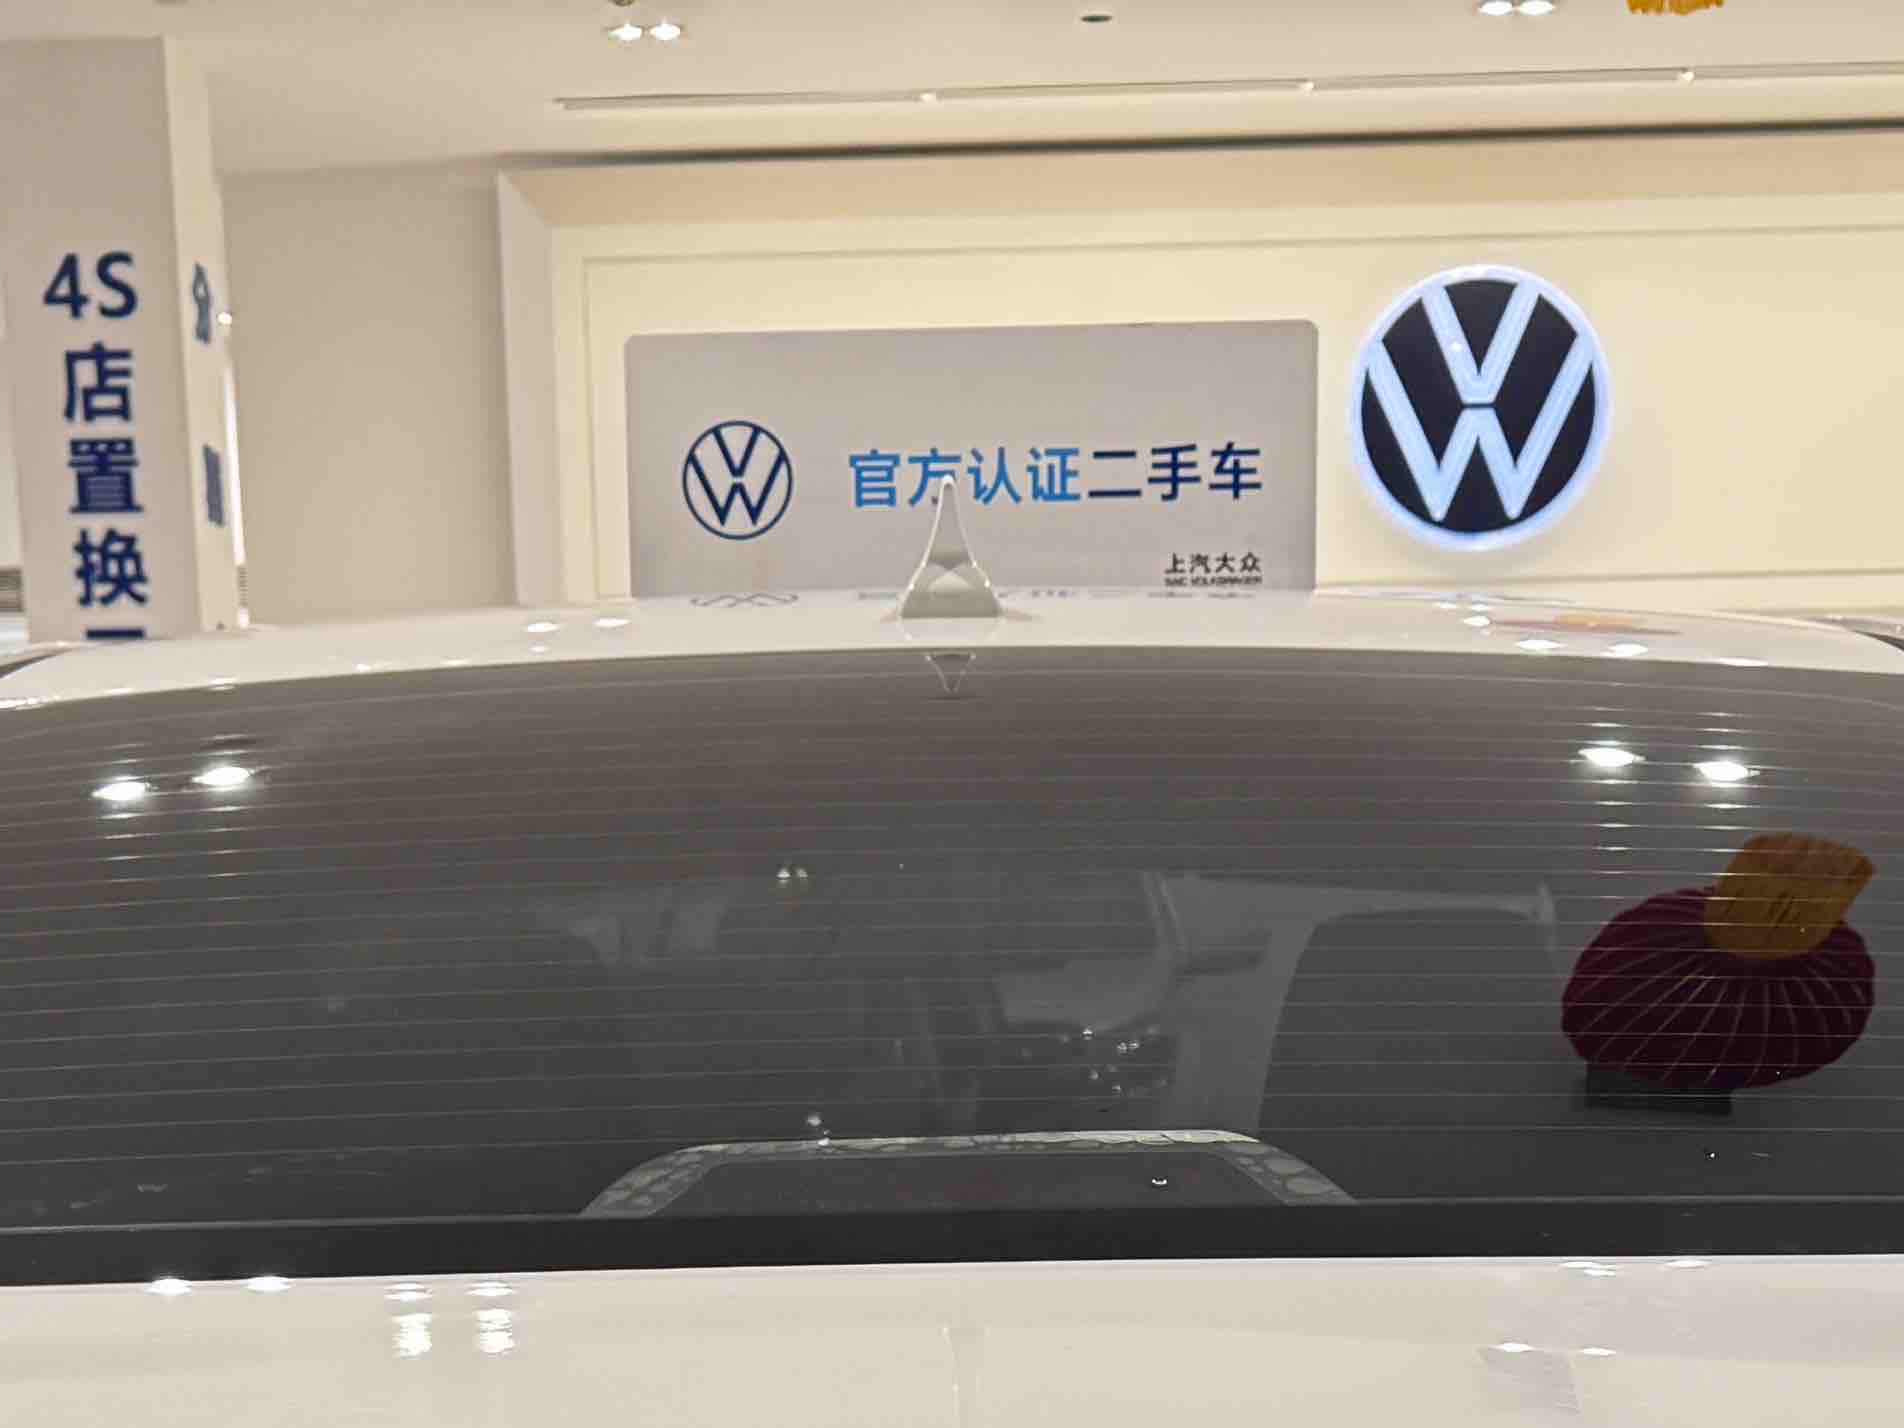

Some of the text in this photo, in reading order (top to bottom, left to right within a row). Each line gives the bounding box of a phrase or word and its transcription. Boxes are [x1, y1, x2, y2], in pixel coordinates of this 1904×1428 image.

[849, 442, 1263, 508] 官方认证二手车
[1164, 551, 1262, 574] 上汽大众
